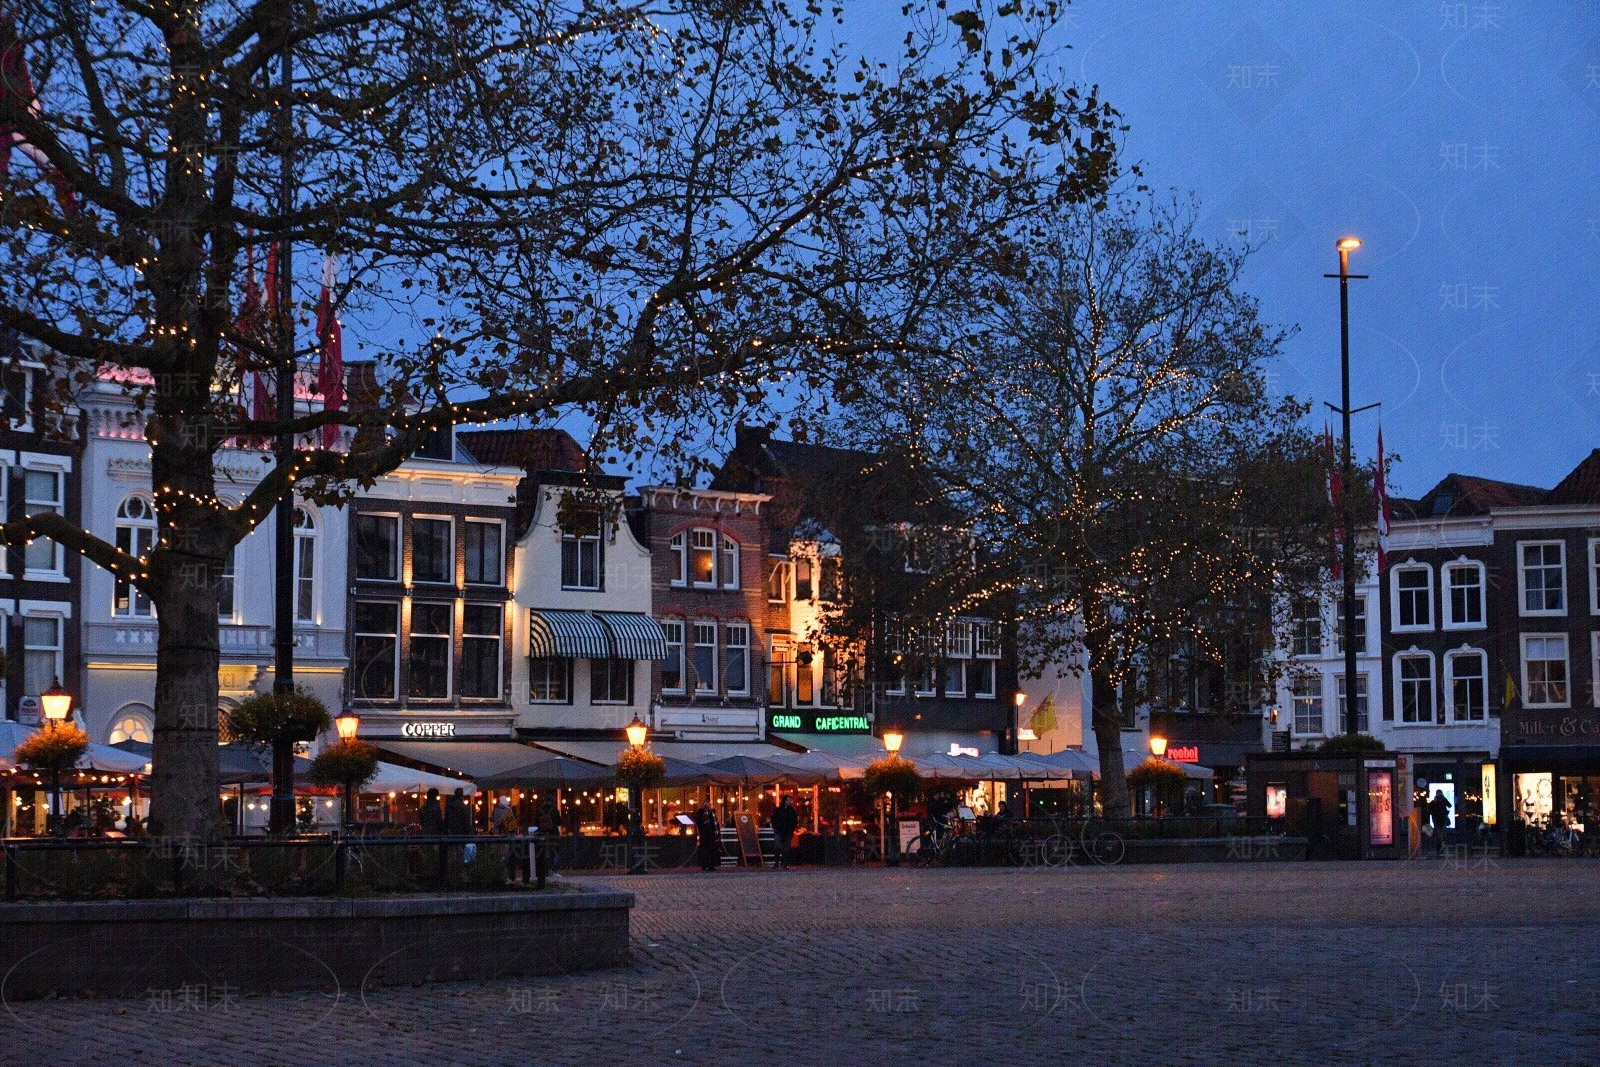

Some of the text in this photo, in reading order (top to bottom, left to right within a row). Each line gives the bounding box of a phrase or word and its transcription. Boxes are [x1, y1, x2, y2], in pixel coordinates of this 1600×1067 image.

[401, 722, 456, 737] COPPER
[773, 715, 801, 728] GRAND
[833, 717, 869, 730] CENTRAL
[1560, 717, 1577, 736] &
